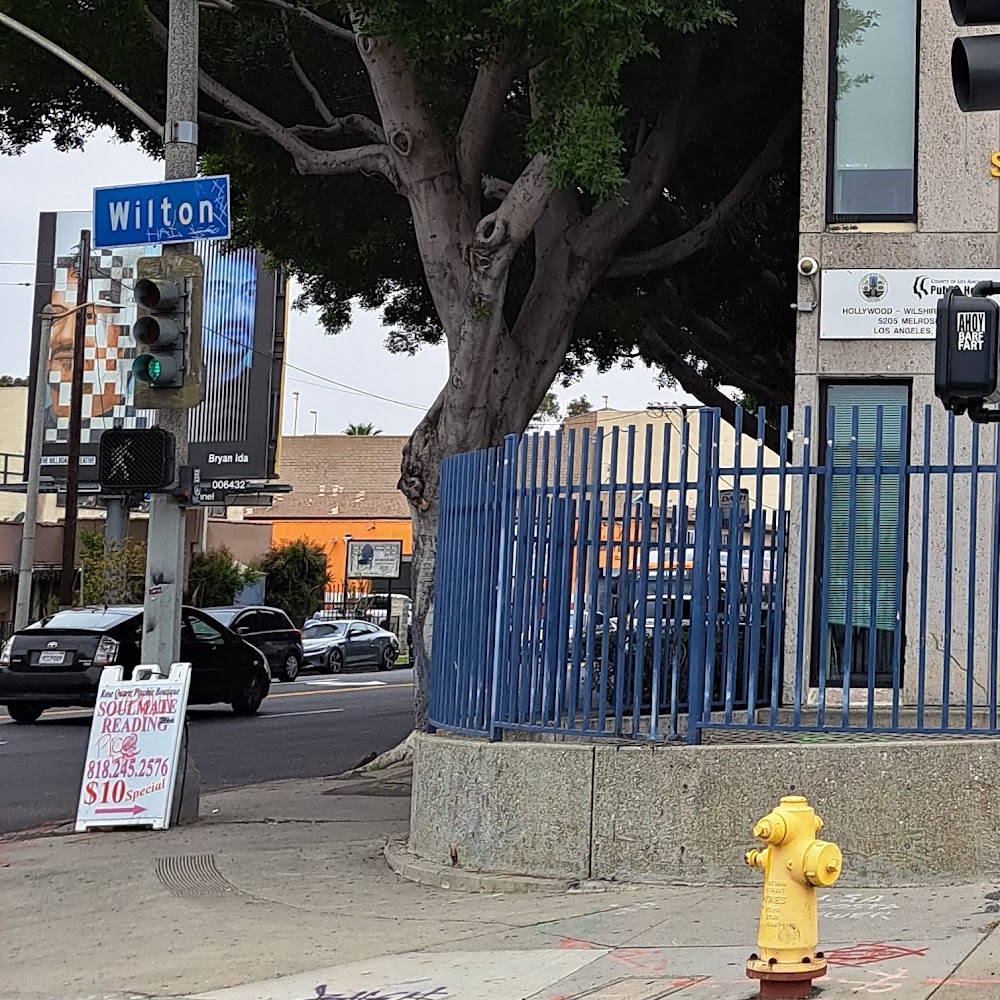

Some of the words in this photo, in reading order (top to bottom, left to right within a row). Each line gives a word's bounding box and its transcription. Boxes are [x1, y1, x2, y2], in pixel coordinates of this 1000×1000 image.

[109, 197, 214, 232] Wilton
[842, 307, 893, 315] HOLLYWOOD
[904, 307, 937, 315] WILSHIR
[877, 317, 899, 325] 5205
[902, 317, 936, 325] MELROS
[959, 313, 984, 332] AHOY
[893, 327, 934, 335] ANGELES,
[958, 341, 985, 350] FART
[208, 453, 233, 464] Bryan
[235, 453, 249, 463] Ida
[212, 480, 246, 489] 006432
[722, 494, 747, 502] DAH
[100, 689, 114, 698] Rose
[97, 699, 177, 716] SOULMATE
[101, 716, 168, 733] READING
[87, 757, 169, 779] 818.245.2576
[84, 779, 126, 806] $10
[125, 778, 166, 802] Special
